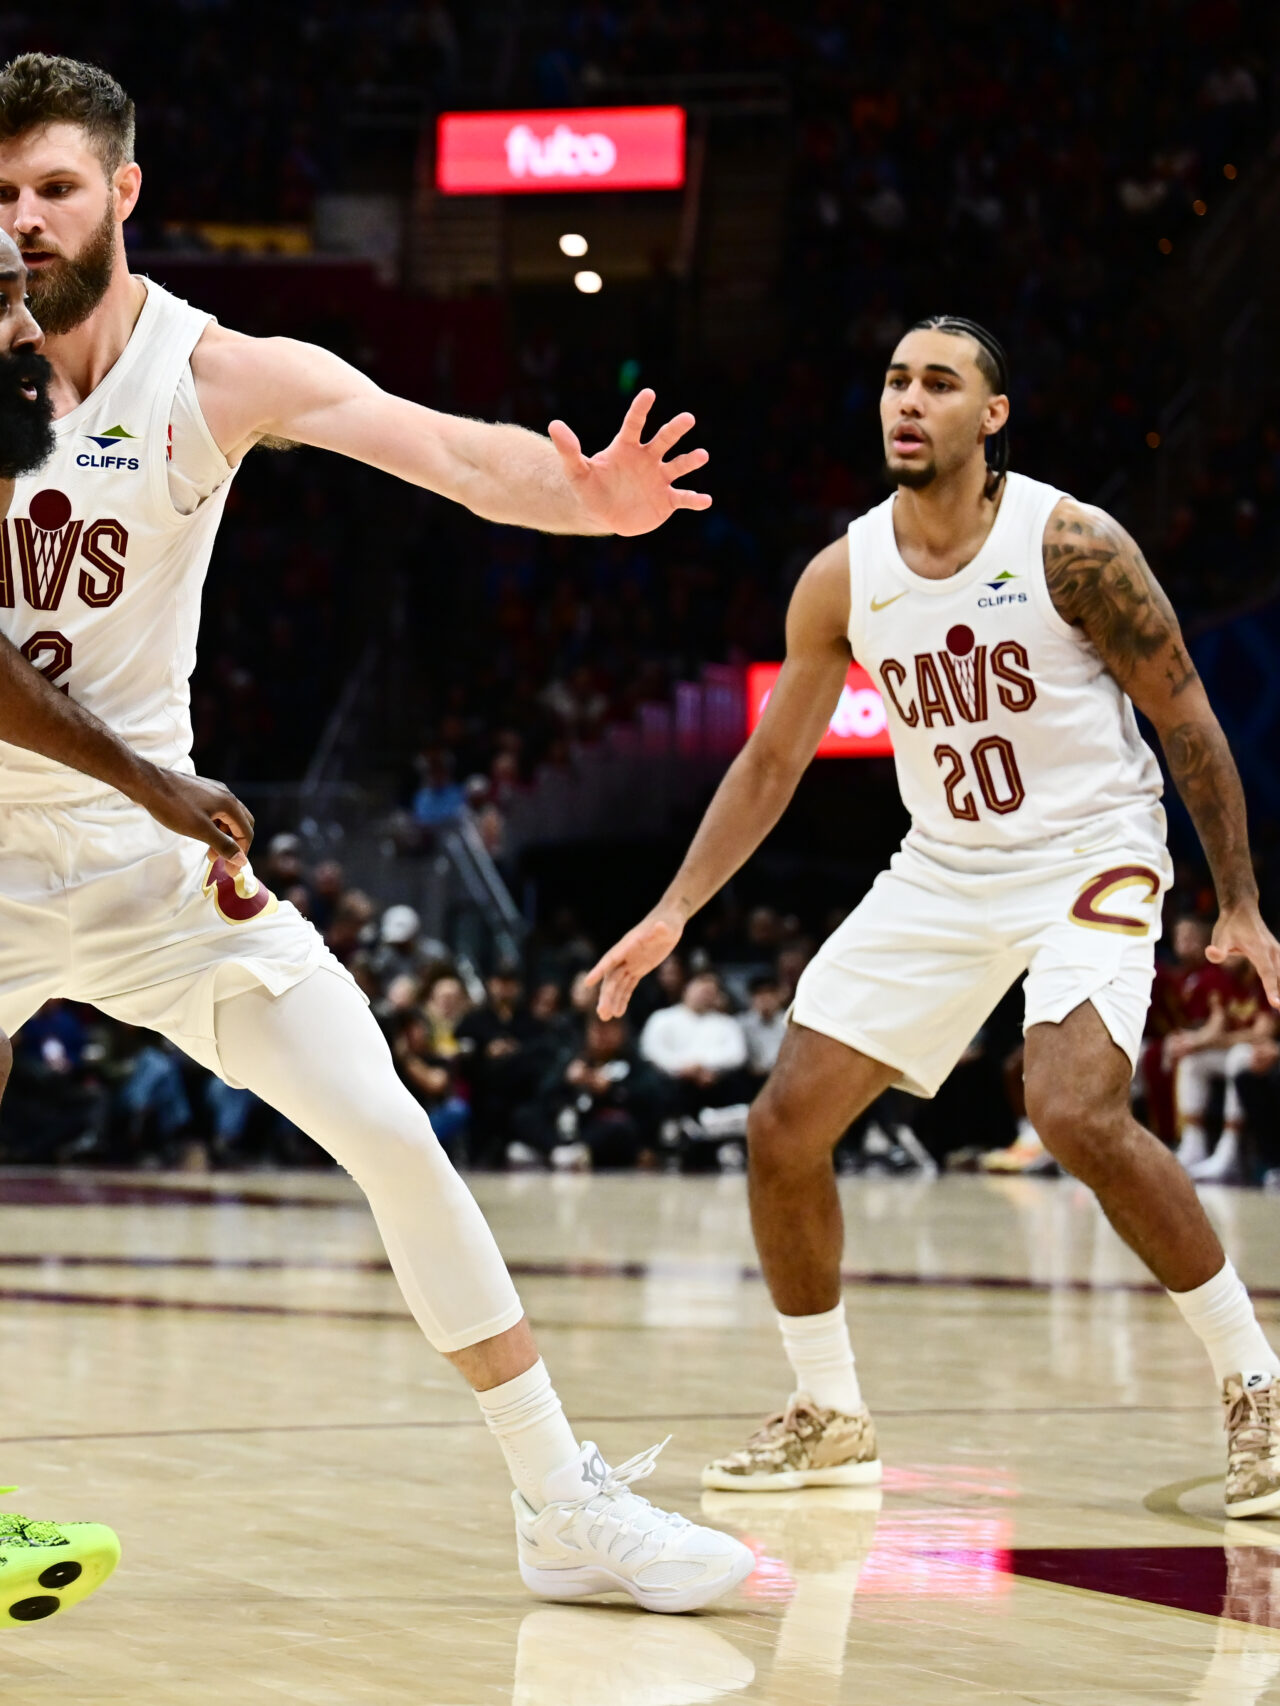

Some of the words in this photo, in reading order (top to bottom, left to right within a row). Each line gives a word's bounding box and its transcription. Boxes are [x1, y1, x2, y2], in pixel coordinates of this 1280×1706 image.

[76, 454, 139, 470] CLIFFS
[977, 592, 1027, 608] CLIFFS
[20, 630, 73, 697] 2
[879, 640, 1037, 728] CAVS
[934, 734, 1026, 821] 20
